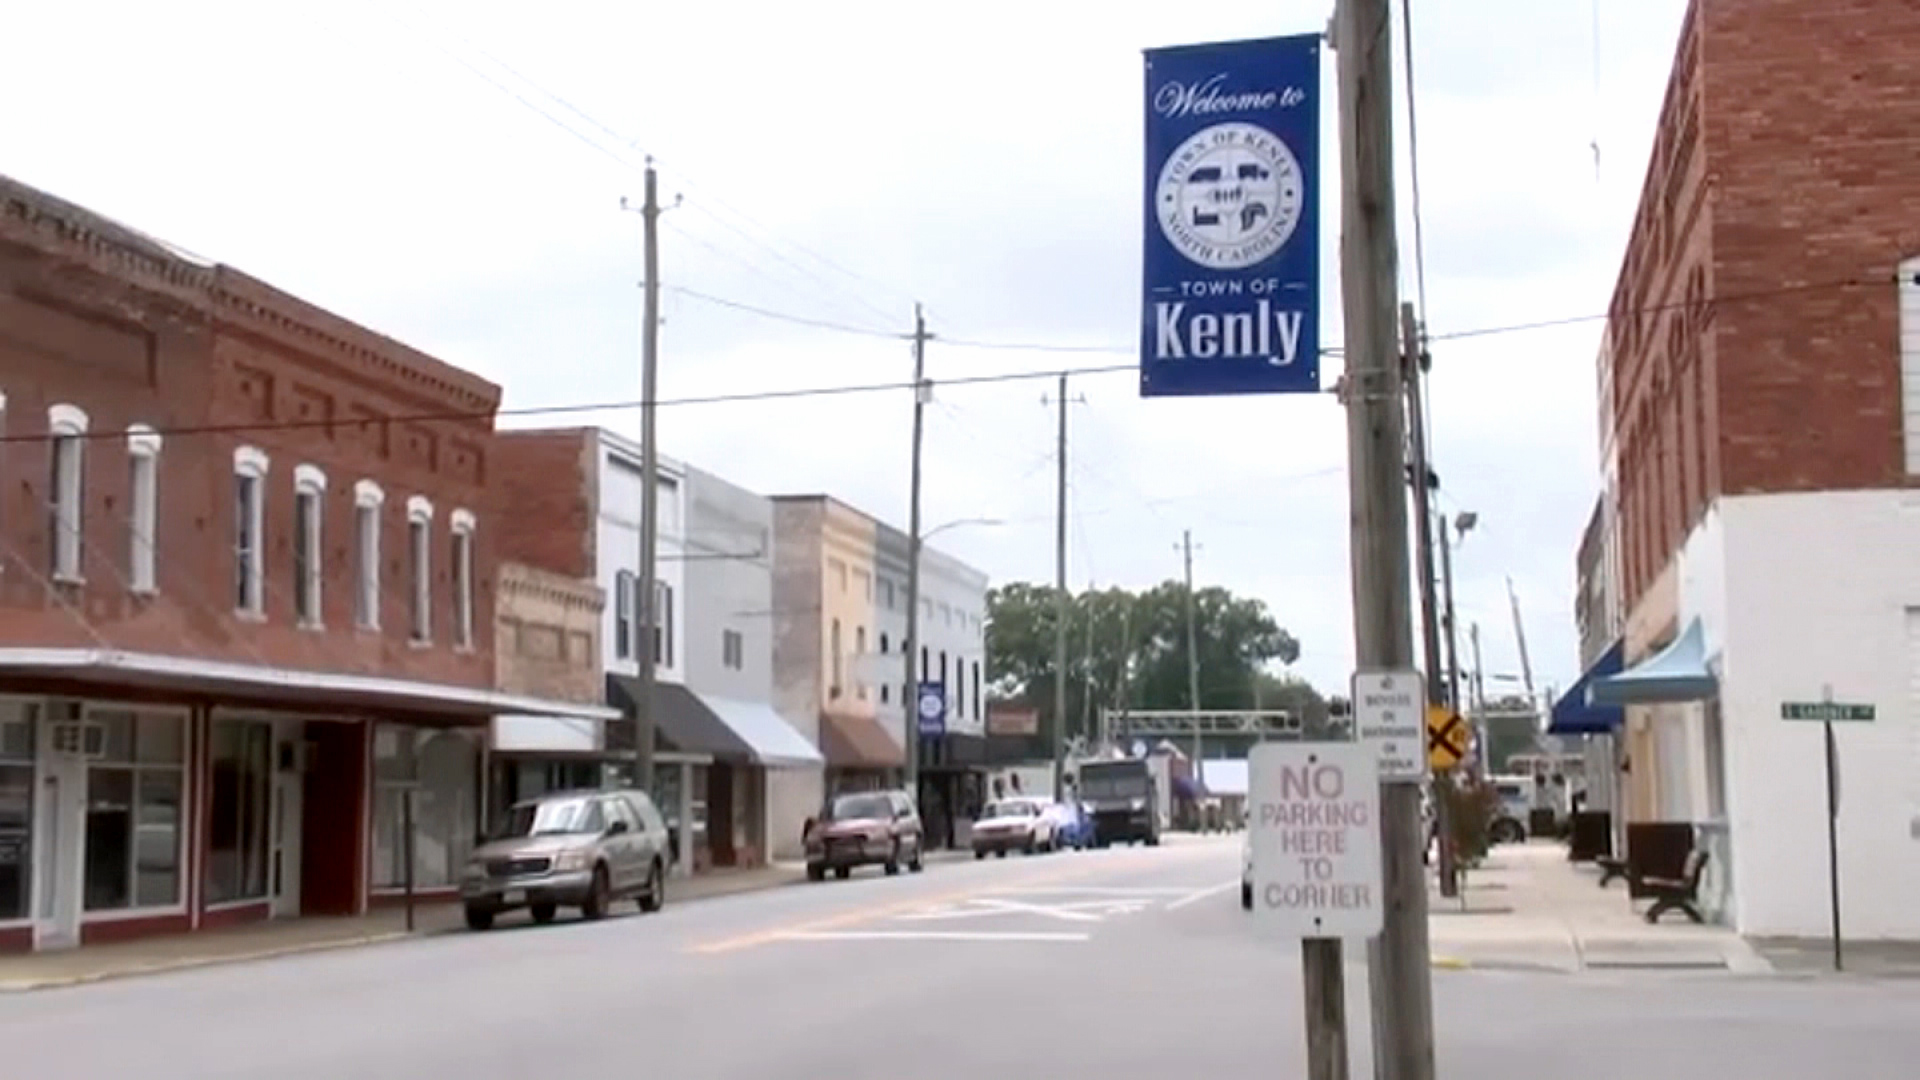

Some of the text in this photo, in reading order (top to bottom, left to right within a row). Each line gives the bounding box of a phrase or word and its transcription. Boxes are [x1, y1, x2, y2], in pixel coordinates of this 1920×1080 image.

[1154, 73, 1304, 118] Welcome to
[1168, 131, 1292, 184] TOWN OF KENLY
[1168, 207, 1294, 261] NORTH CAROLINA
[1181, 279, 1279, 297] TOWN OF
[1155, 299, 1303, 367] Kenly
[1280, 765, 1344, 800] NO
[1260, 802, 1369, 826] PARKING
[1282, 831, 1345, 855] HERE
[1299, 857, 1333, 881] TO
[1264, 882, 1371, 909] CORNER
